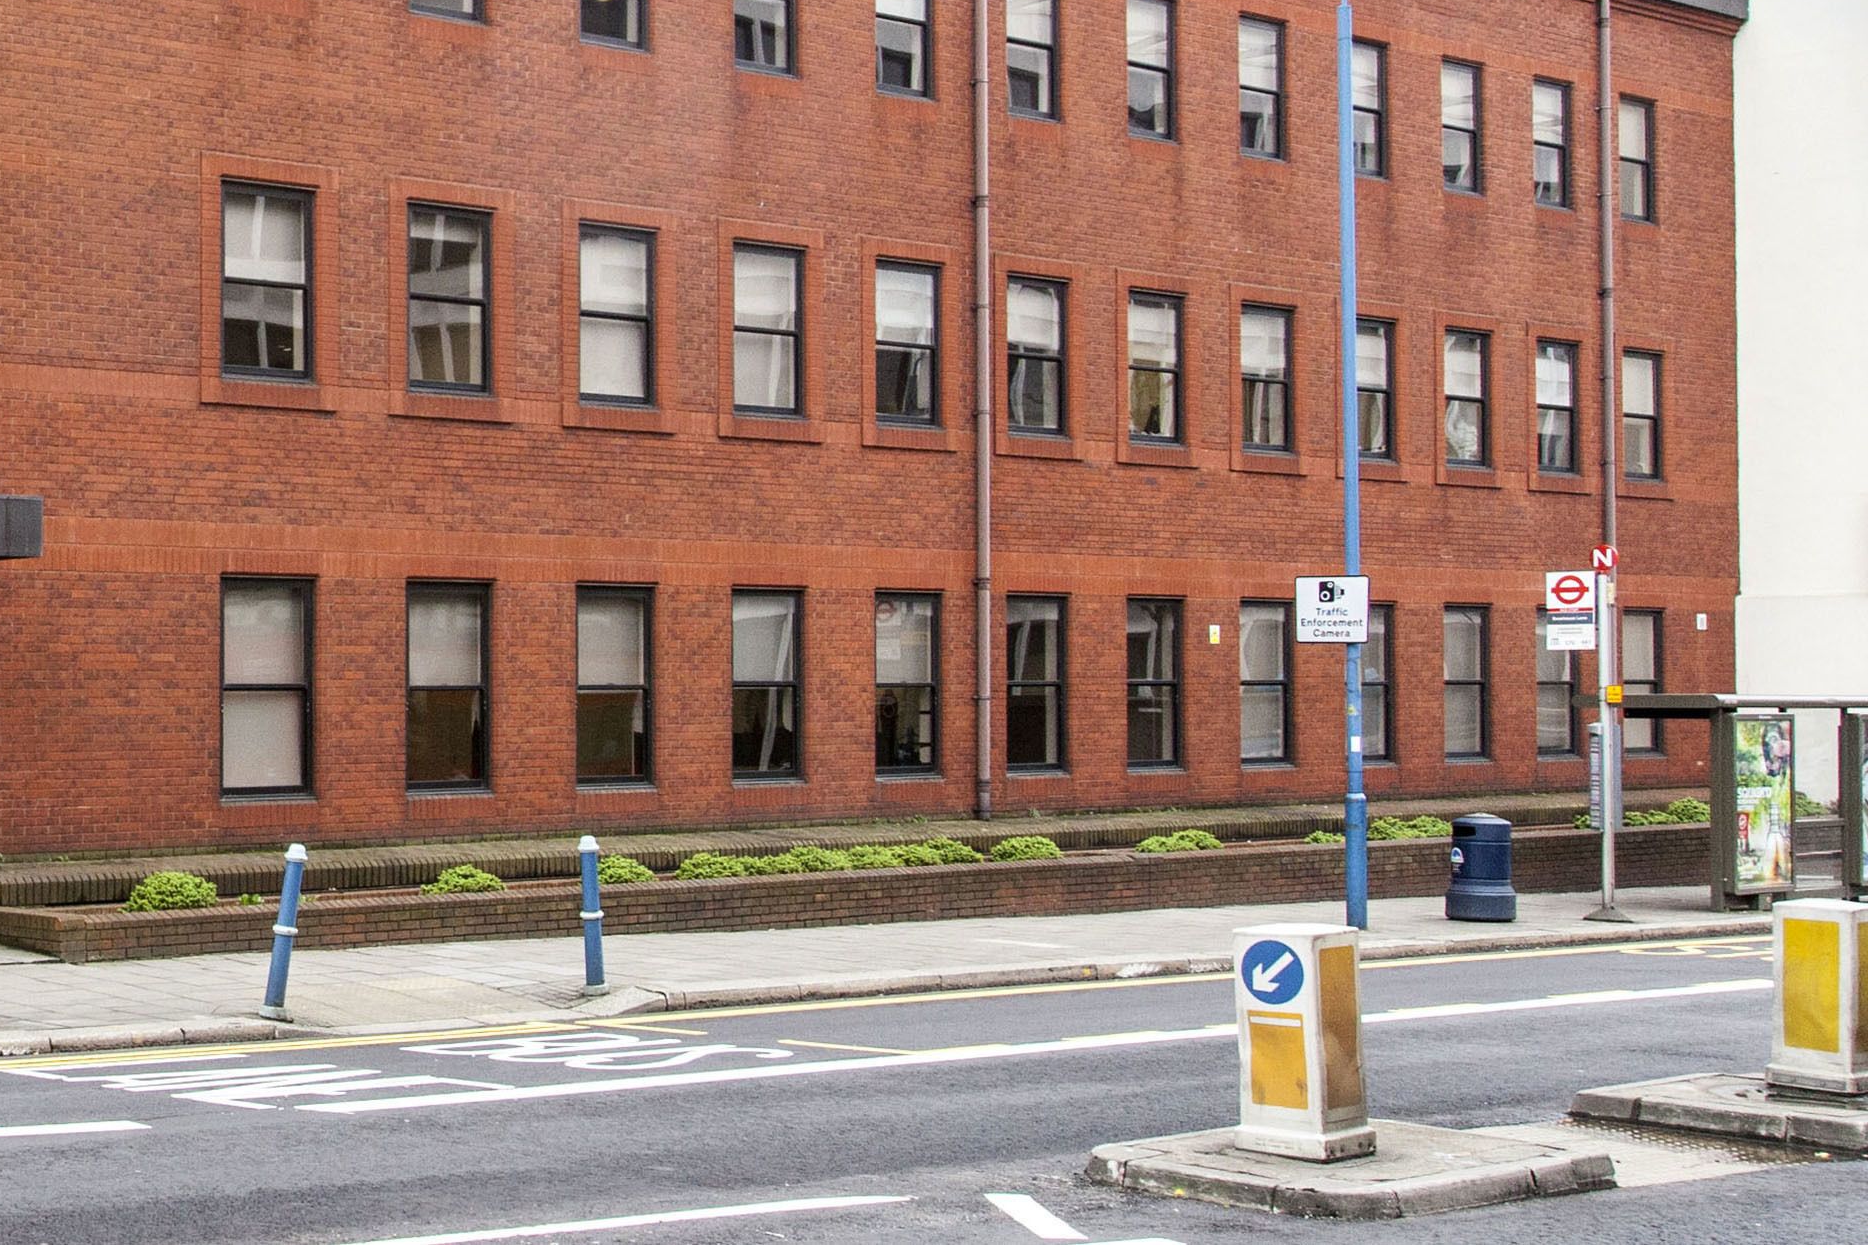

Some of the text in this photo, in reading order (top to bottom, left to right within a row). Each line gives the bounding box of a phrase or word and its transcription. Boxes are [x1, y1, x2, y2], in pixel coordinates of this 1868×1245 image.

[1592, 548, 1614, 568] N
[1315, 607, 1349, 616] Traffic
[1300, 618, 1364, 627] Enforcement
[1312, 628, 1351, 638] Camera
